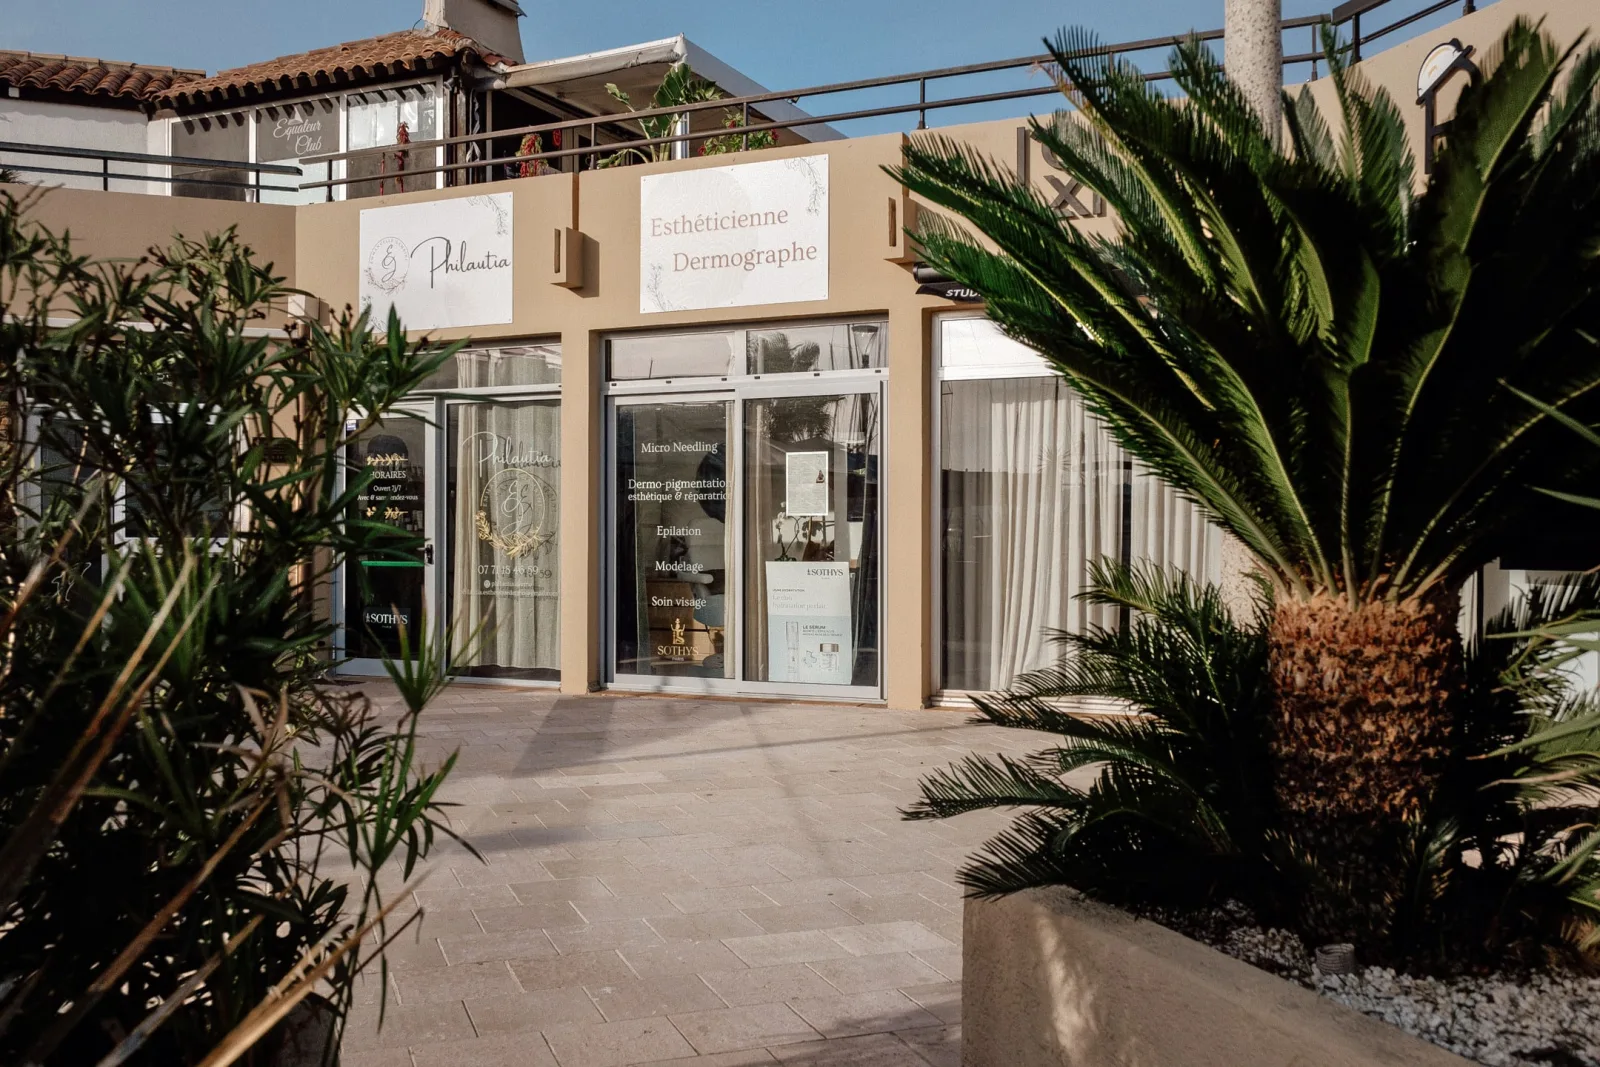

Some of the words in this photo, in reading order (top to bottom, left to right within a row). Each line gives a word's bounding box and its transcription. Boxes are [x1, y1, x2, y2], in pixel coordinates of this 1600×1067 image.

[273, 118, 322, 140] Equateur
[295, 135, 322, 155] Club
[651, 209, 788, 237] Esthéticienne
[410, 236, 511, 289] Philautia
[673, 241, 817, 272] Dermographe
[945, 288, 981, 298] STUD
[461, 431, 550, 478] Philautia
[641, 442, 671, 453] Micro
[673, 441, 719, 454] Needling
[627, 492, 672, 503] esthétique
[674, 491, 682, 501] &
[656, 525, 702, 539] Epilation
[477, 564, 489, 575] 07
[655, 560, 704, 574] Modelage
[811, 568, 844, 577] SOTHYS
[651, 595, 674, 607] Soin
[675, 597, 707, 610] visage
[370, 613, 408, 625] SOTHYS
[657, 645, 699, 656] SOTHYS
